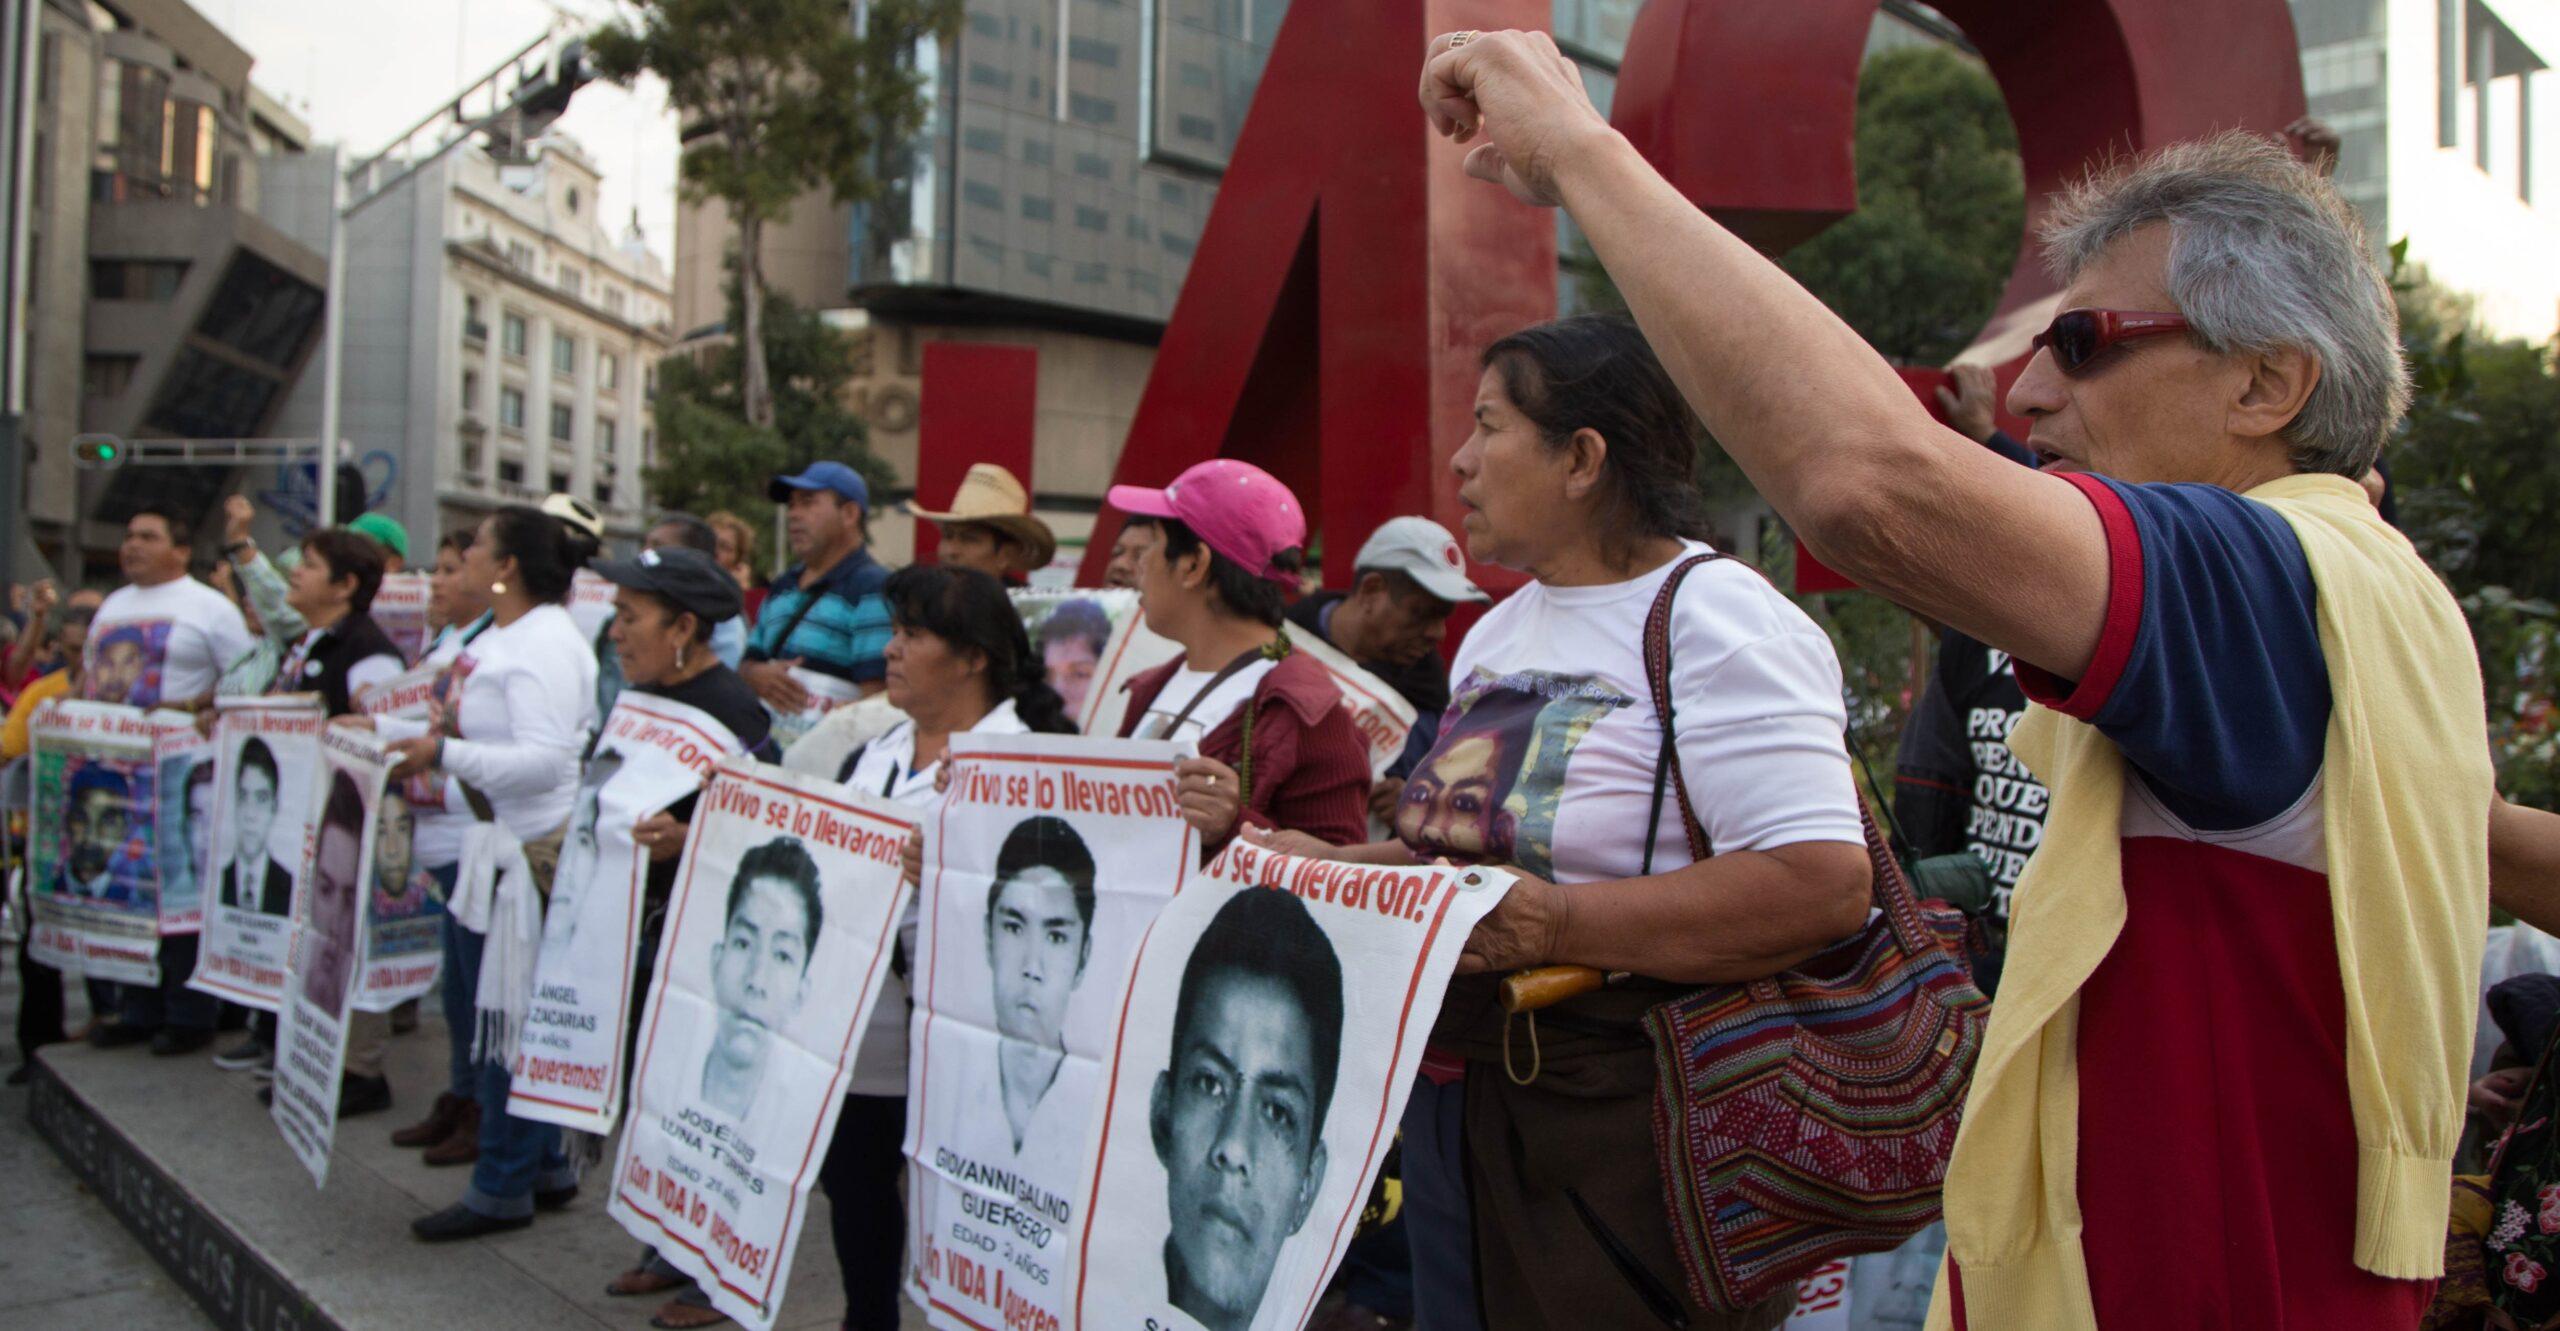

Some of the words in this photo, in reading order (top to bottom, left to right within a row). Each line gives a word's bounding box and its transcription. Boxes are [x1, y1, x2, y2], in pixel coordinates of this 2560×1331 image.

[1971, 741, 2037, 780] PEN
[1006, 774, 1029, 807] se
[1034, 769, 1056, 811] lo
[1061, 770, 1185, 819] llevaron!
[1975, 774, 2050, 816] QUE
[709, 780, 761, 820] ¡Vivo
[765, 800, 789, 830] se
[791, 803, 812, 837] lo
[813, 809, 907, 868] llevaron!
[1231, 845, 1259, 886] se
[1259, 851, 1290, 892] lo
[1290, 857, 1445, 924] llevaron!
[677, 1107, 732, 1142] JOSÉ
[689, 1191, 708, 1229] lo
[946, 1248, 988, 1306] VIDA
[994, 1268, 1004, 1310] l
[952, 1223, 997, 1253] EDAD
[1014, 1253, 1050, 1286] AÑOS
